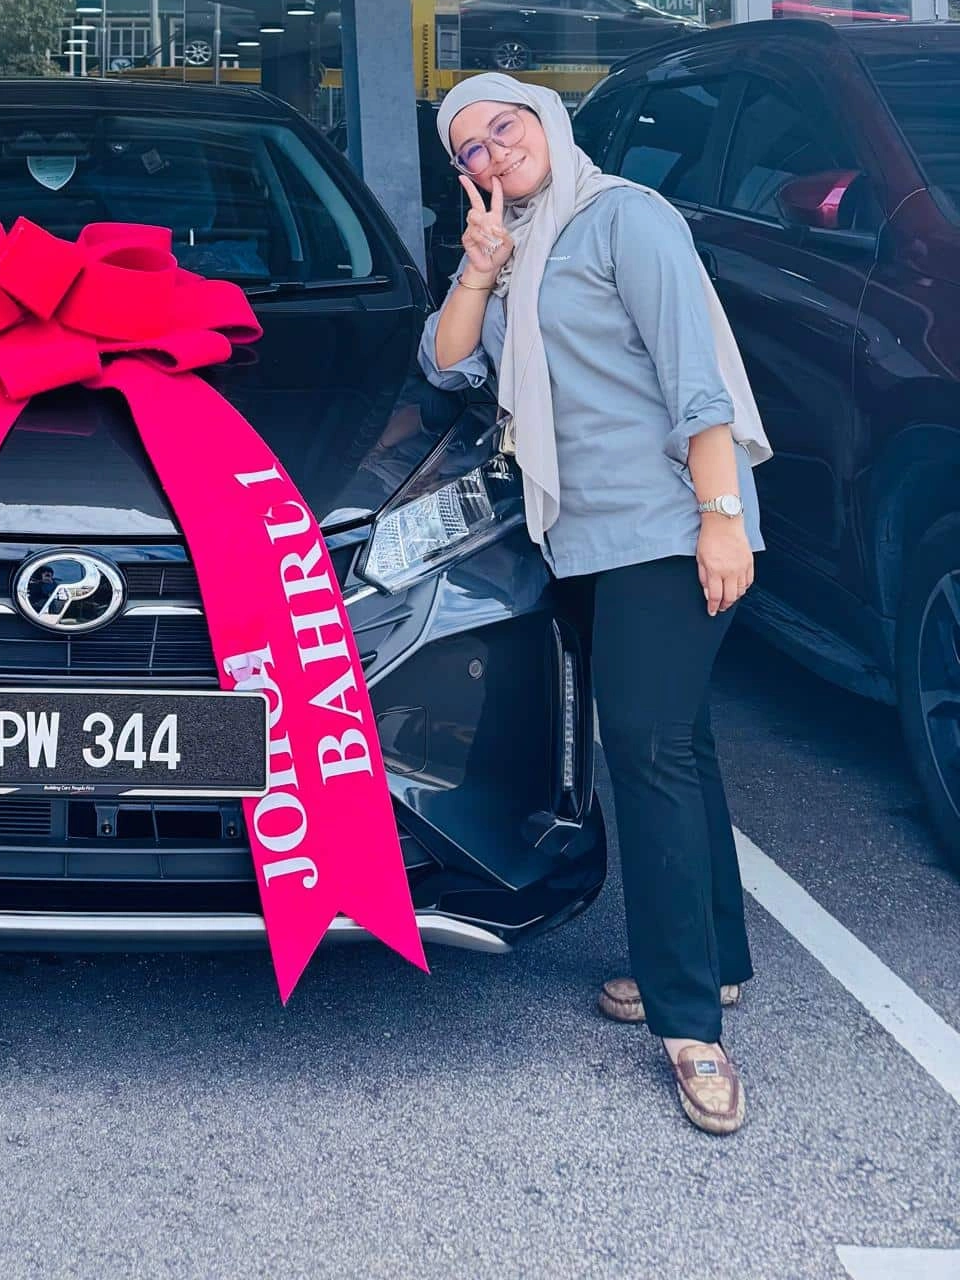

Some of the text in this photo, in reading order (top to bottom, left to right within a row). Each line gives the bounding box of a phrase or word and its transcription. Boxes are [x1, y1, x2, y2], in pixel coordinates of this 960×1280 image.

[233, 462, 374, 786] BAHRU 1
[82, 711, 182, 770] 344
